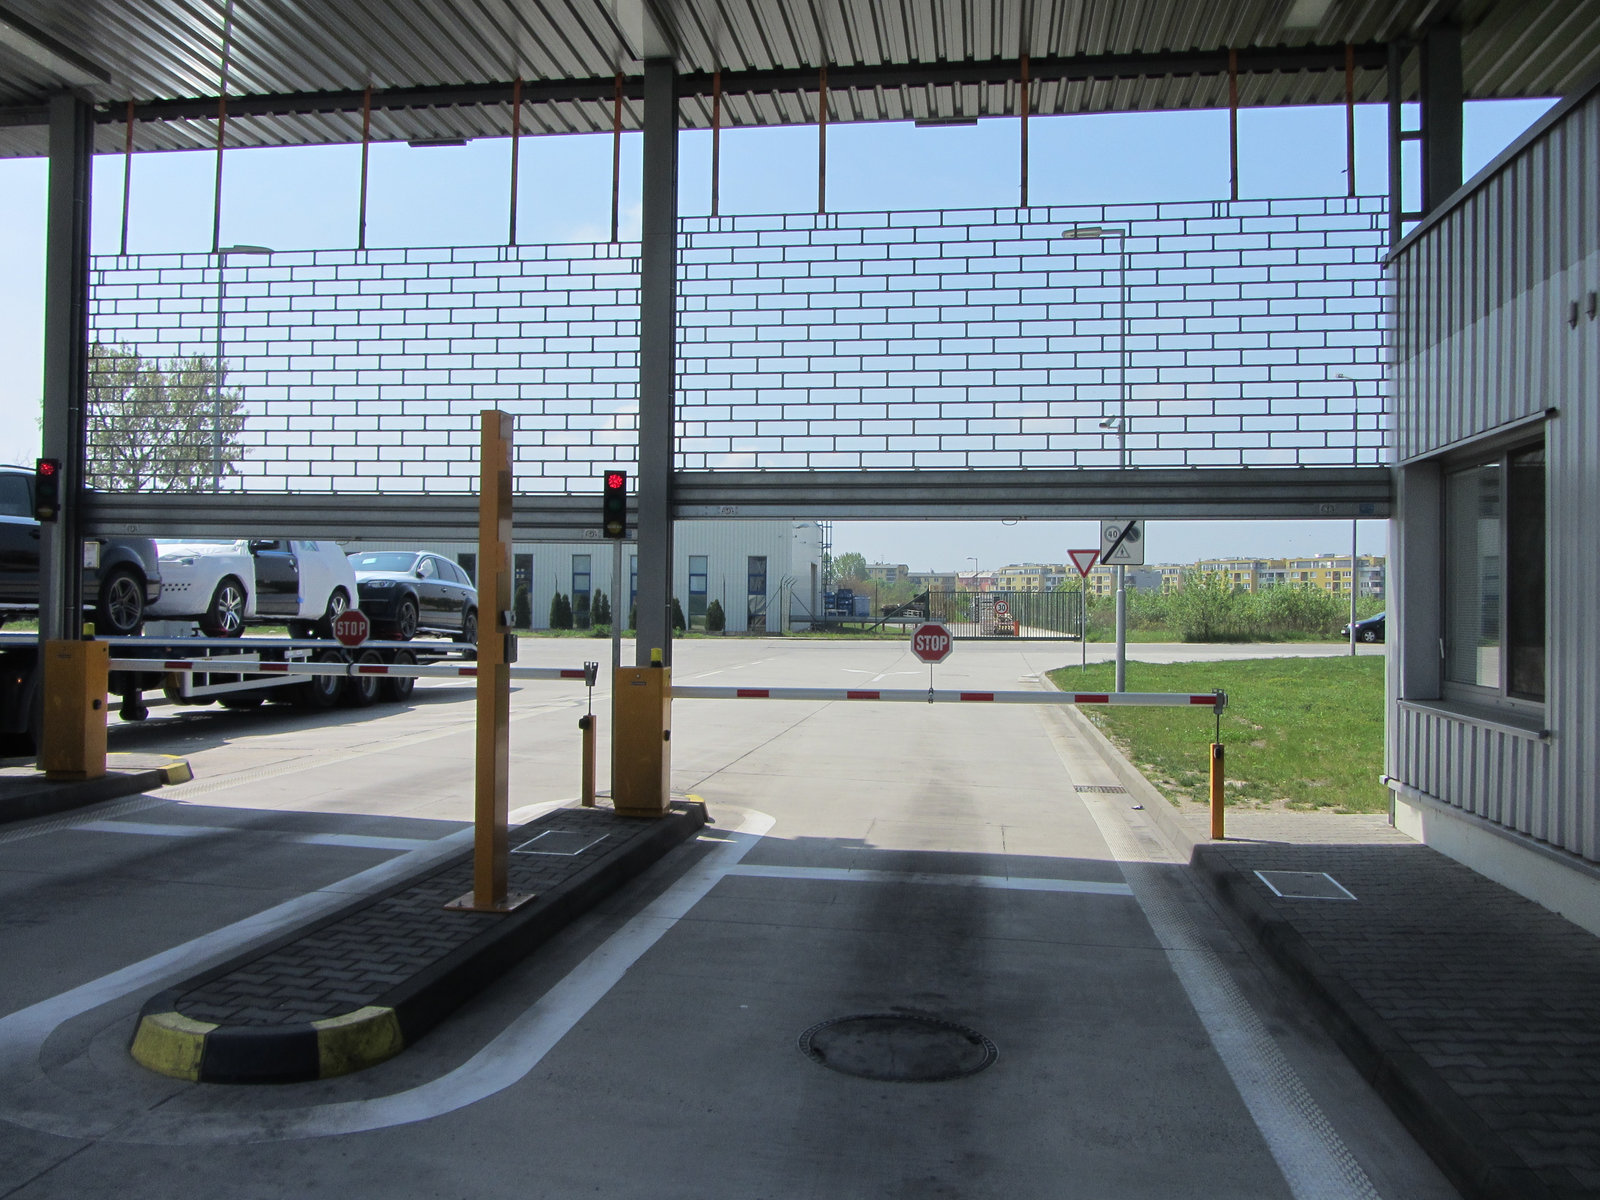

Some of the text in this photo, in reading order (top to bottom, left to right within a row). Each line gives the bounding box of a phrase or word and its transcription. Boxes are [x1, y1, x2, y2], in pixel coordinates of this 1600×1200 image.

[1107, 530, 1118, 538] 40
[336, 621, 366, 636] STOP
[916, 635, 948, 651] STOP
